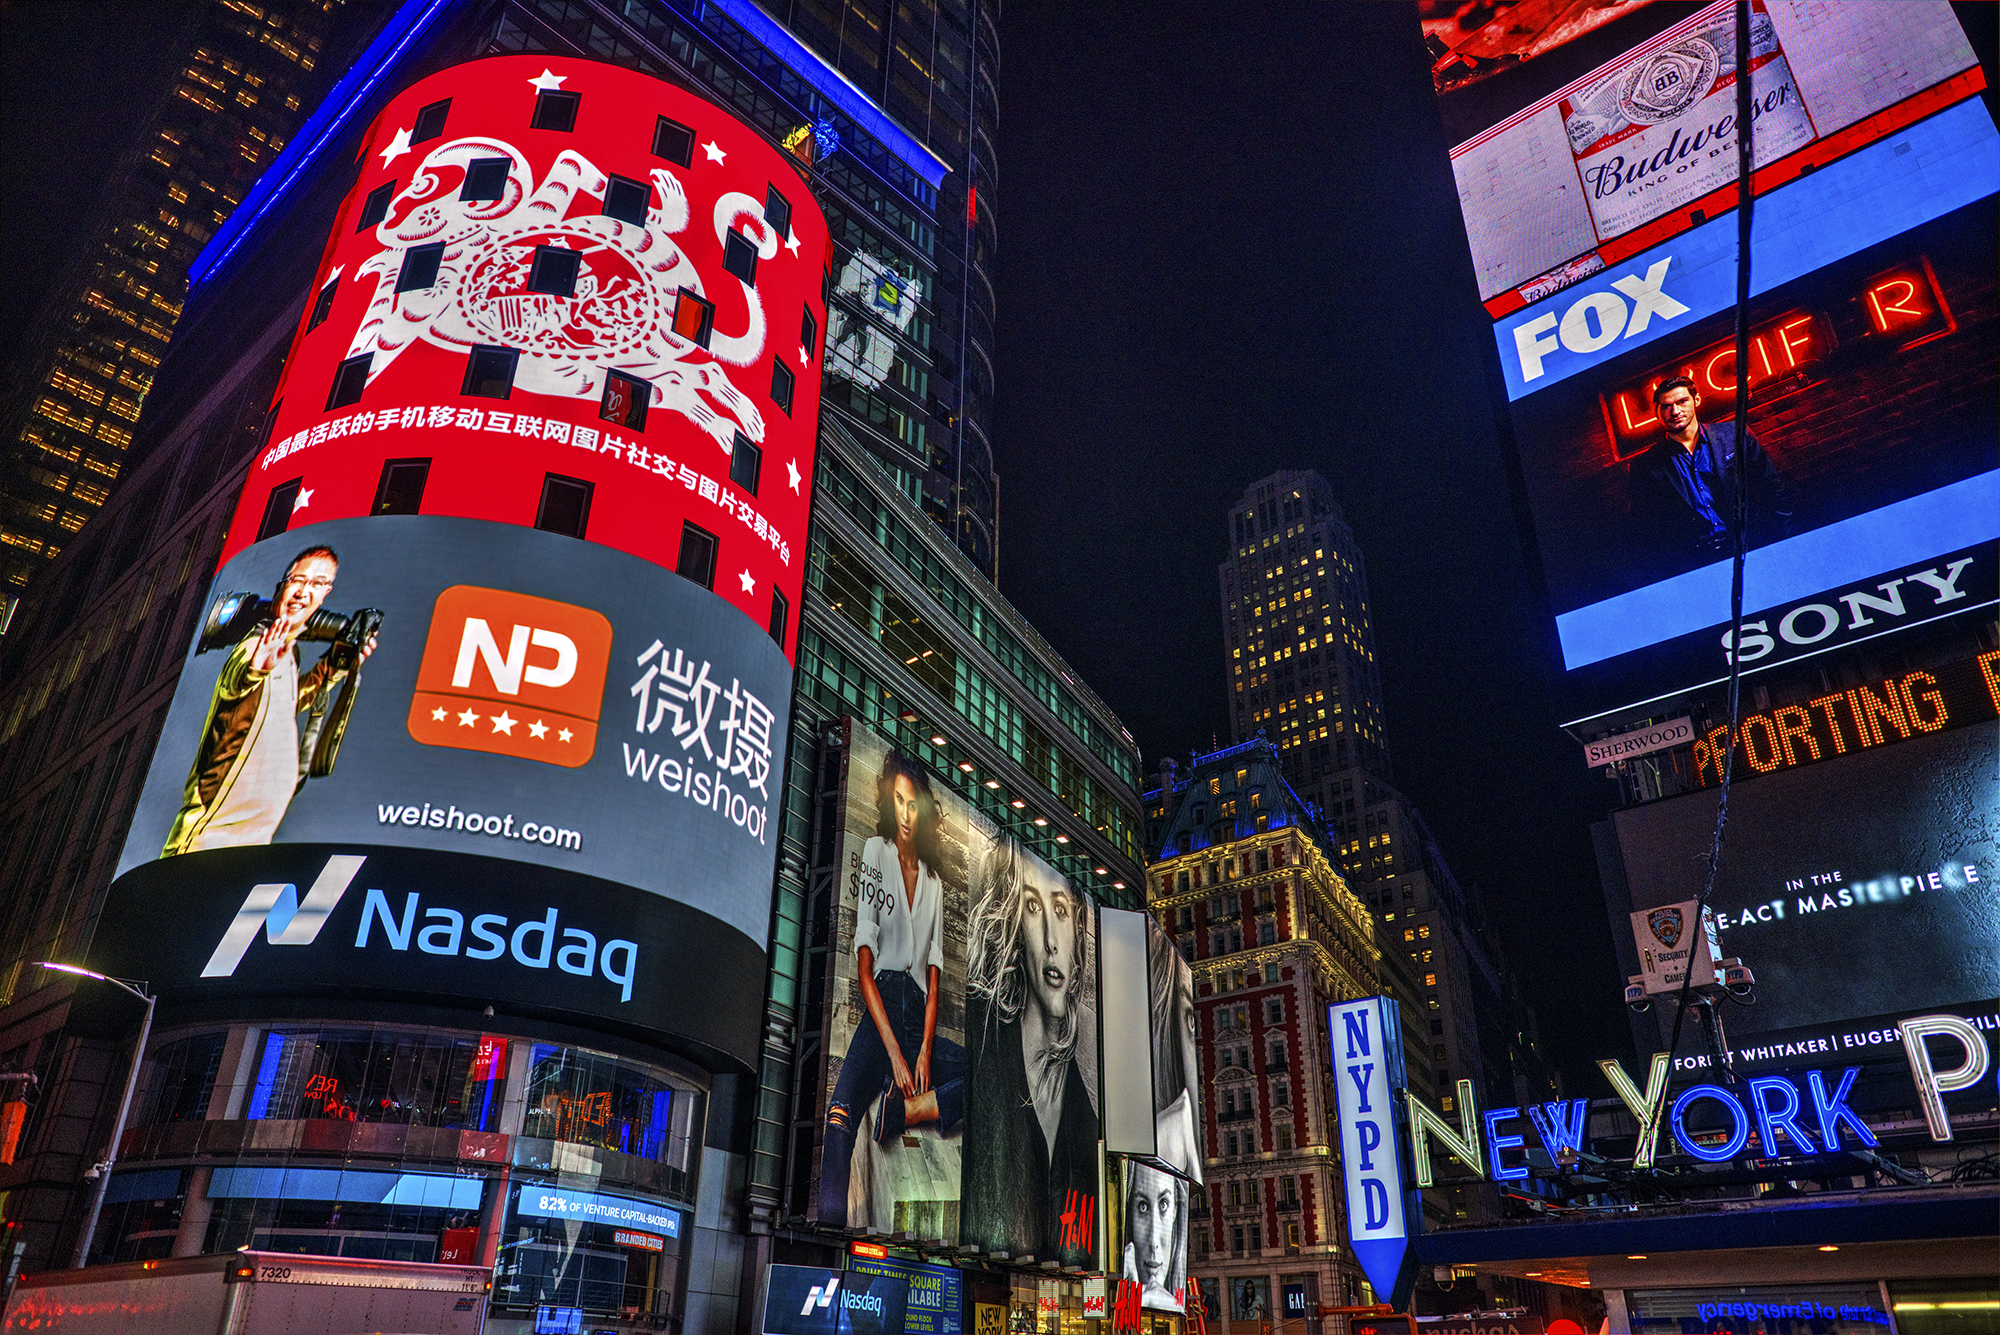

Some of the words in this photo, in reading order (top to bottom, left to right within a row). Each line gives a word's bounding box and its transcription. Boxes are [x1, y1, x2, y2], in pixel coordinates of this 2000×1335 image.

[1655, 71, 1680, 92] AB
[1585, 81, 1792, 200] Budweser
[1628, 174, 1668, 197] KING
[1676, 158, 1699, 174] OF
[1709, 125, 1763, 159] BES
[1513, 256, 1691, 383] FOX
[261, 405, 791, 567] 中国最活跃的手机移动互联网图片社交与图片交易平台
[1721, 557, 1974, 666] SONY
[630, 639, 775, 801] 微摄
[1589, 724, 1689, 763] SHERWOOD
[622, 742, 767, 847] weishoot
[377, 802, 583, 851] weishoot.com
[850, 850, 884, 884] Blouse
[1786, 878, 1804, 892] IN
[1810, 870, 1843, 887] THE
[849, 874, 895, 917] $19.99
[355, 888, 638, 1003] Nasdaq
[1658, 947, 1689, 963] SECURITY
[1627, 987, 1643, 998] NYPD
[1673, 1050, 1734, 1071] FORT
[1740, 1038, 1829, 1062] WHITAKER
[1342, 1008, 1390, 1232] NYPD
[1403, 1079, 1590, 1189] NEW
[1595, 1051, 1883, 1170] YORK
[539, 1195, 567, 1213] 82%
[569, 1202, 581, 1212] OF
[583, 1202, 620, 1219] VENTURE
[620, 1207, 668, 1228] CAPITAL-BACKED
[1059, 1187, 1095, 1256] H&M
[614, 1231, 647, 1247] BRANDED
[647, 1236, 663, 1250] CITIES
[261, 1266, 291, 1279] 7320
[909, 1274, 941, 1292] SQUARE
[840, 1288, 882, 1318] Nasdaq
[1084, 1296, 1105, 1313] H&M
[1113, 1278, 1142, 1334] H&M
[1174, 1286, 1185, 1307] H&M
[905, 1321, 920, 1333] LOWER
[921, 1323, 934, 1333] LEVELS
[920, 1314, 932, 1324] FLOOR
[980, 1306, 1001, 1327] NEW
